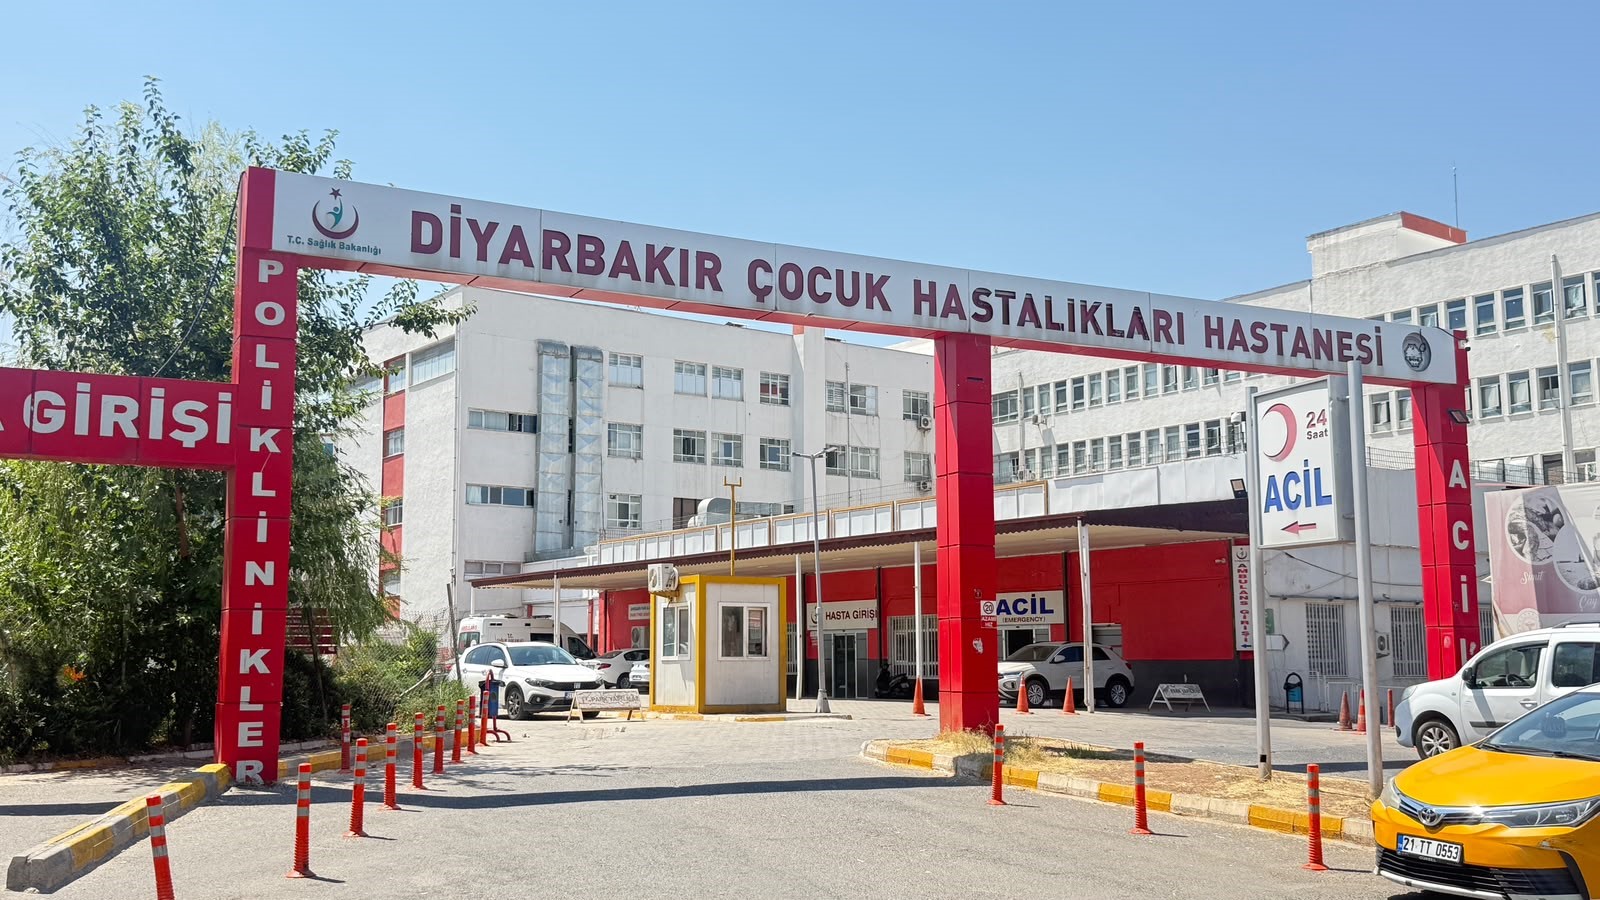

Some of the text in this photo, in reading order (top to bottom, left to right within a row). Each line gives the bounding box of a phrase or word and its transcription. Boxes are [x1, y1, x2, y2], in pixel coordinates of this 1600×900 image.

[287, 235, 381, 256] T.C. Sağlık Bakanlığı
[410, 204, 1383, 367] DİYARBAKIR ÇOCUK HASTALIKLARI HASTANESİ
[23, 382, 232, 448] GİRİŞİ
[1306, 409, 1327, 429] 24
[1307, 428, 1328, 440] Saat
[1264, 459, 1333, 514] ACİL
[236, 259, 285, 785] POLİKLİNİKLER
[825, 611, 851, 621] HASTA
[996, 593, 1055, 616] ACİL
[1403, 837, 1414, 851] 21
[1420, 840, 1432, 854] TT
[1436, 843, 1459, 860] 0553
